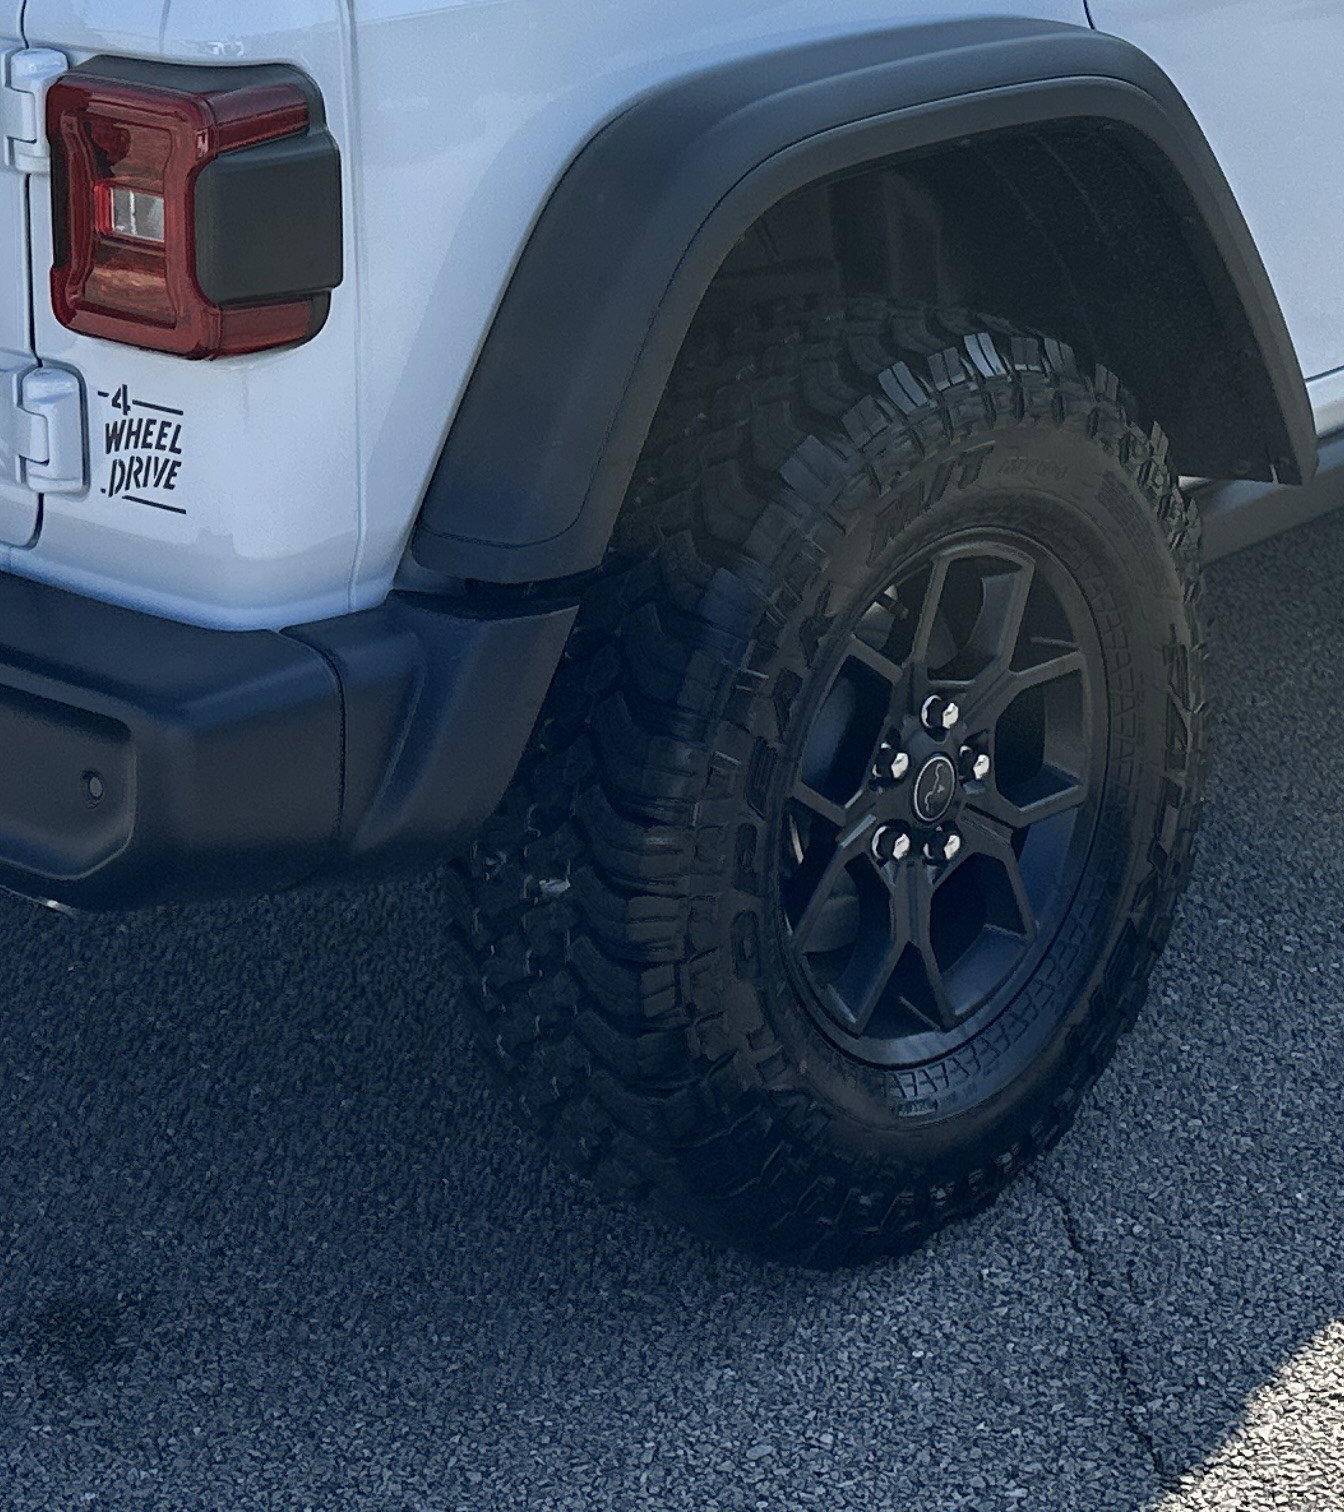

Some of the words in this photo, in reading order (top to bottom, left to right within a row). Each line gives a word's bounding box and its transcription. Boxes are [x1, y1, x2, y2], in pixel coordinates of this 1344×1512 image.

[111, 383, 131, 416] 4
[105, 418, 182, 455] WHEEL
[108, 455, 182, 498] DRIVE
